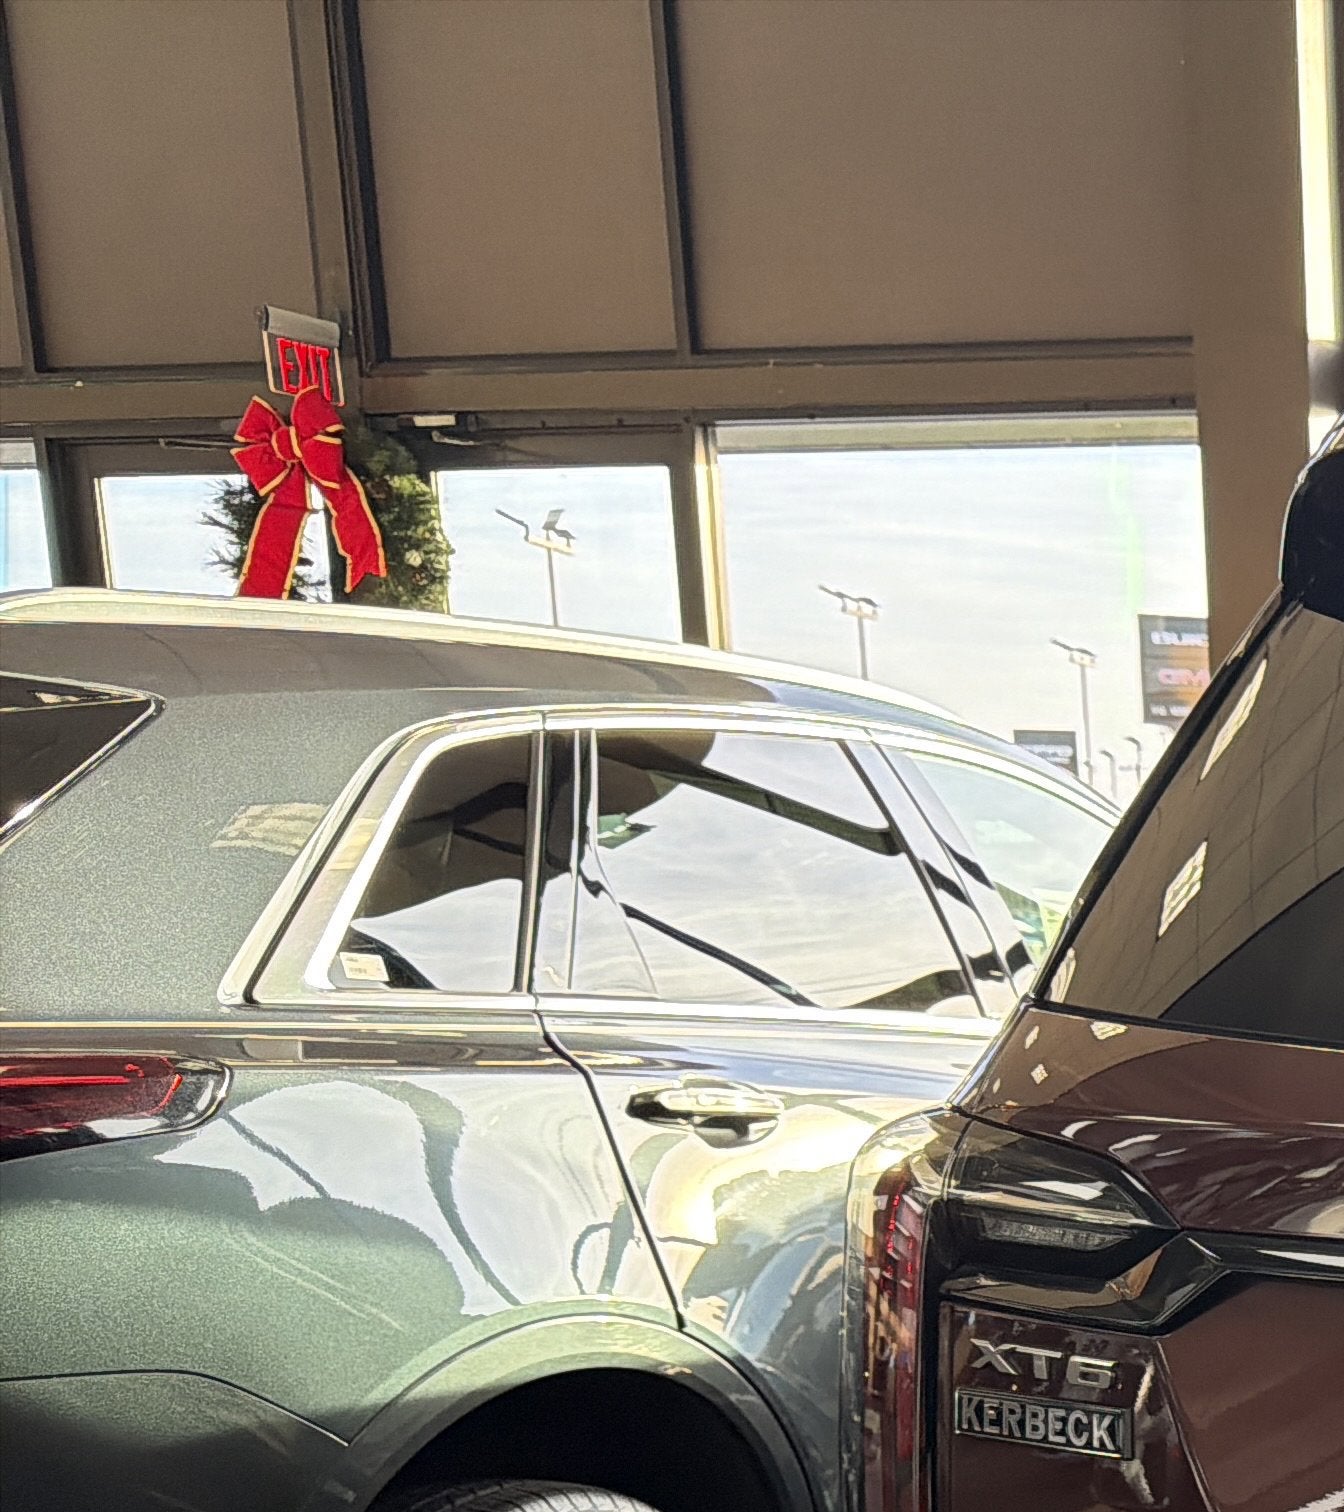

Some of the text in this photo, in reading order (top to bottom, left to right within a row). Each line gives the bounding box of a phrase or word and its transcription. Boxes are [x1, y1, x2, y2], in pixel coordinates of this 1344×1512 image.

[276, 337, 332, 401] EXIT
[970, 1338, 1118, 1389] XT6
[960, 1394, 1116, 1450] KERBECK
